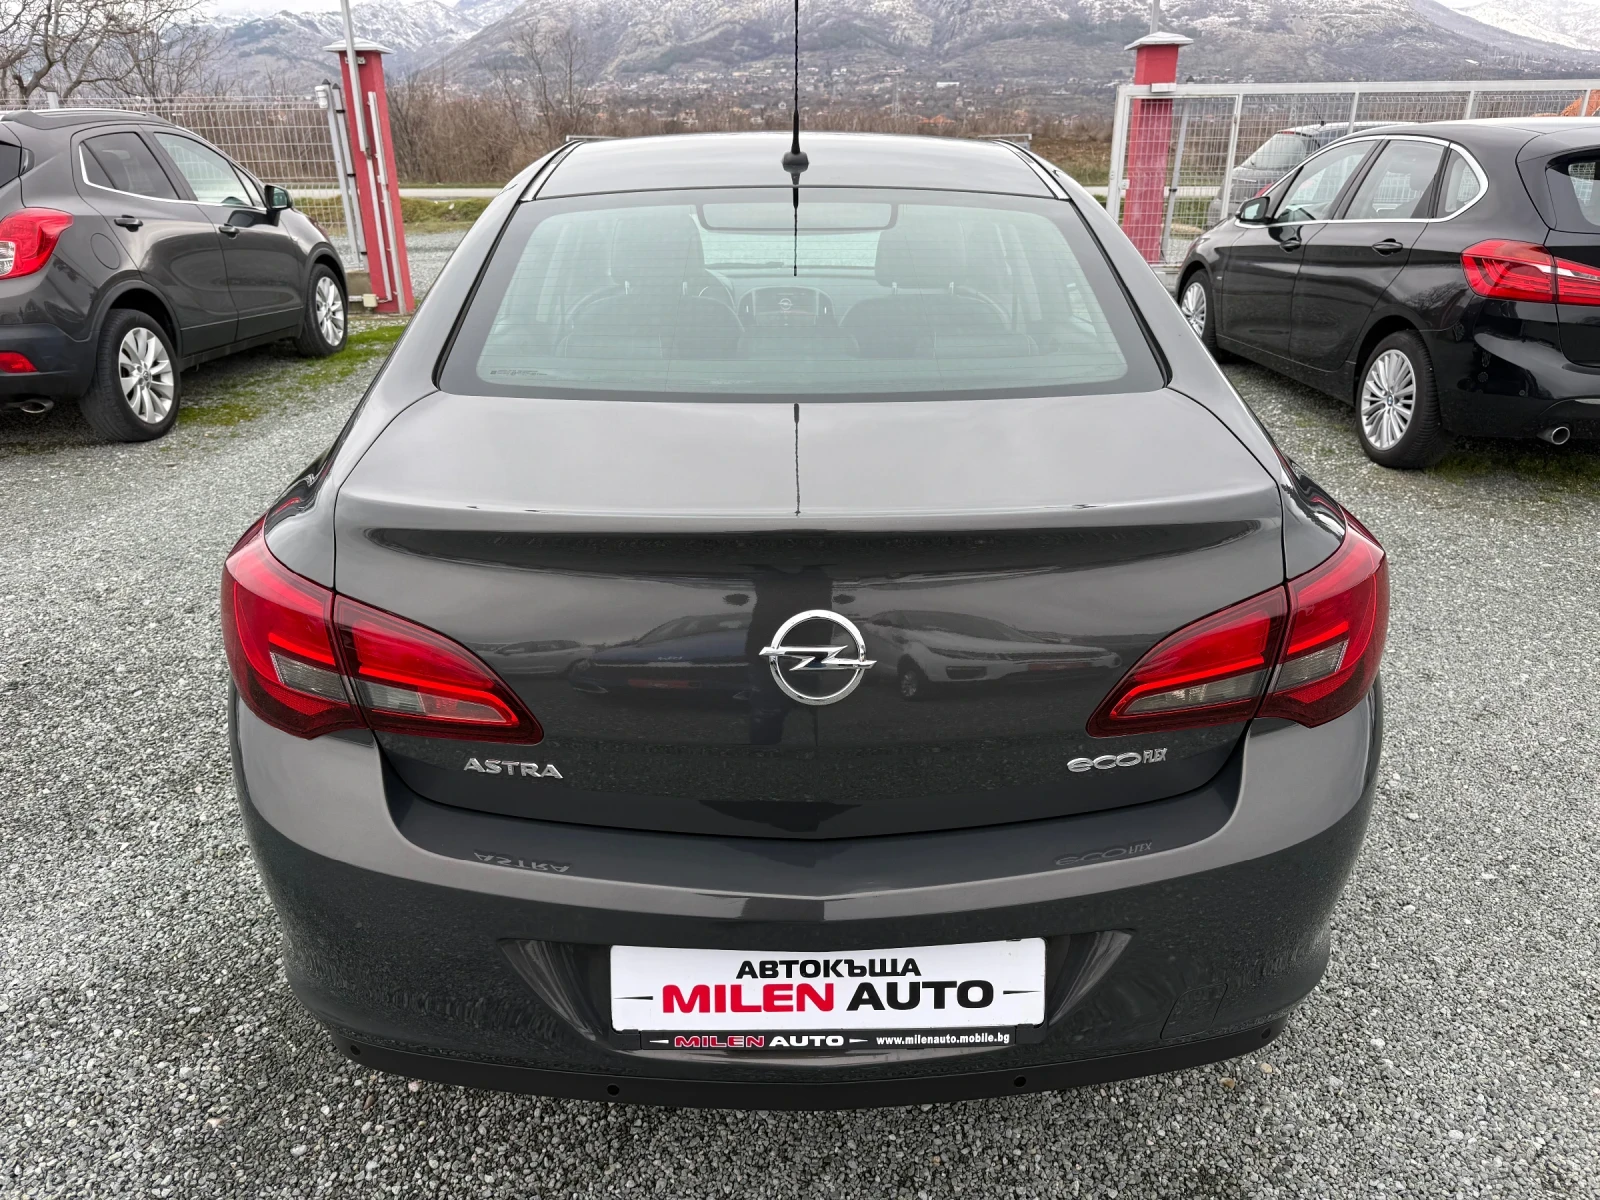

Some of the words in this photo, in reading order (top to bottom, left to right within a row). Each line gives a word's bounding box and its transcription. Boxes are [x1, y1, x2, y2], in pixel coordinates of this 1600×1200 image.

[463, 757, 563, 779] ASTRA
[662, 982, 834, 1013] MILEN
[846, 980, 994, 1011] AUTO
[674, 1035, 765, 1048] MILEN
[768, 1035, 844, 1047] AUTO
[876, 1032, 1010, 1045] www.milenauto.mobile.bg
